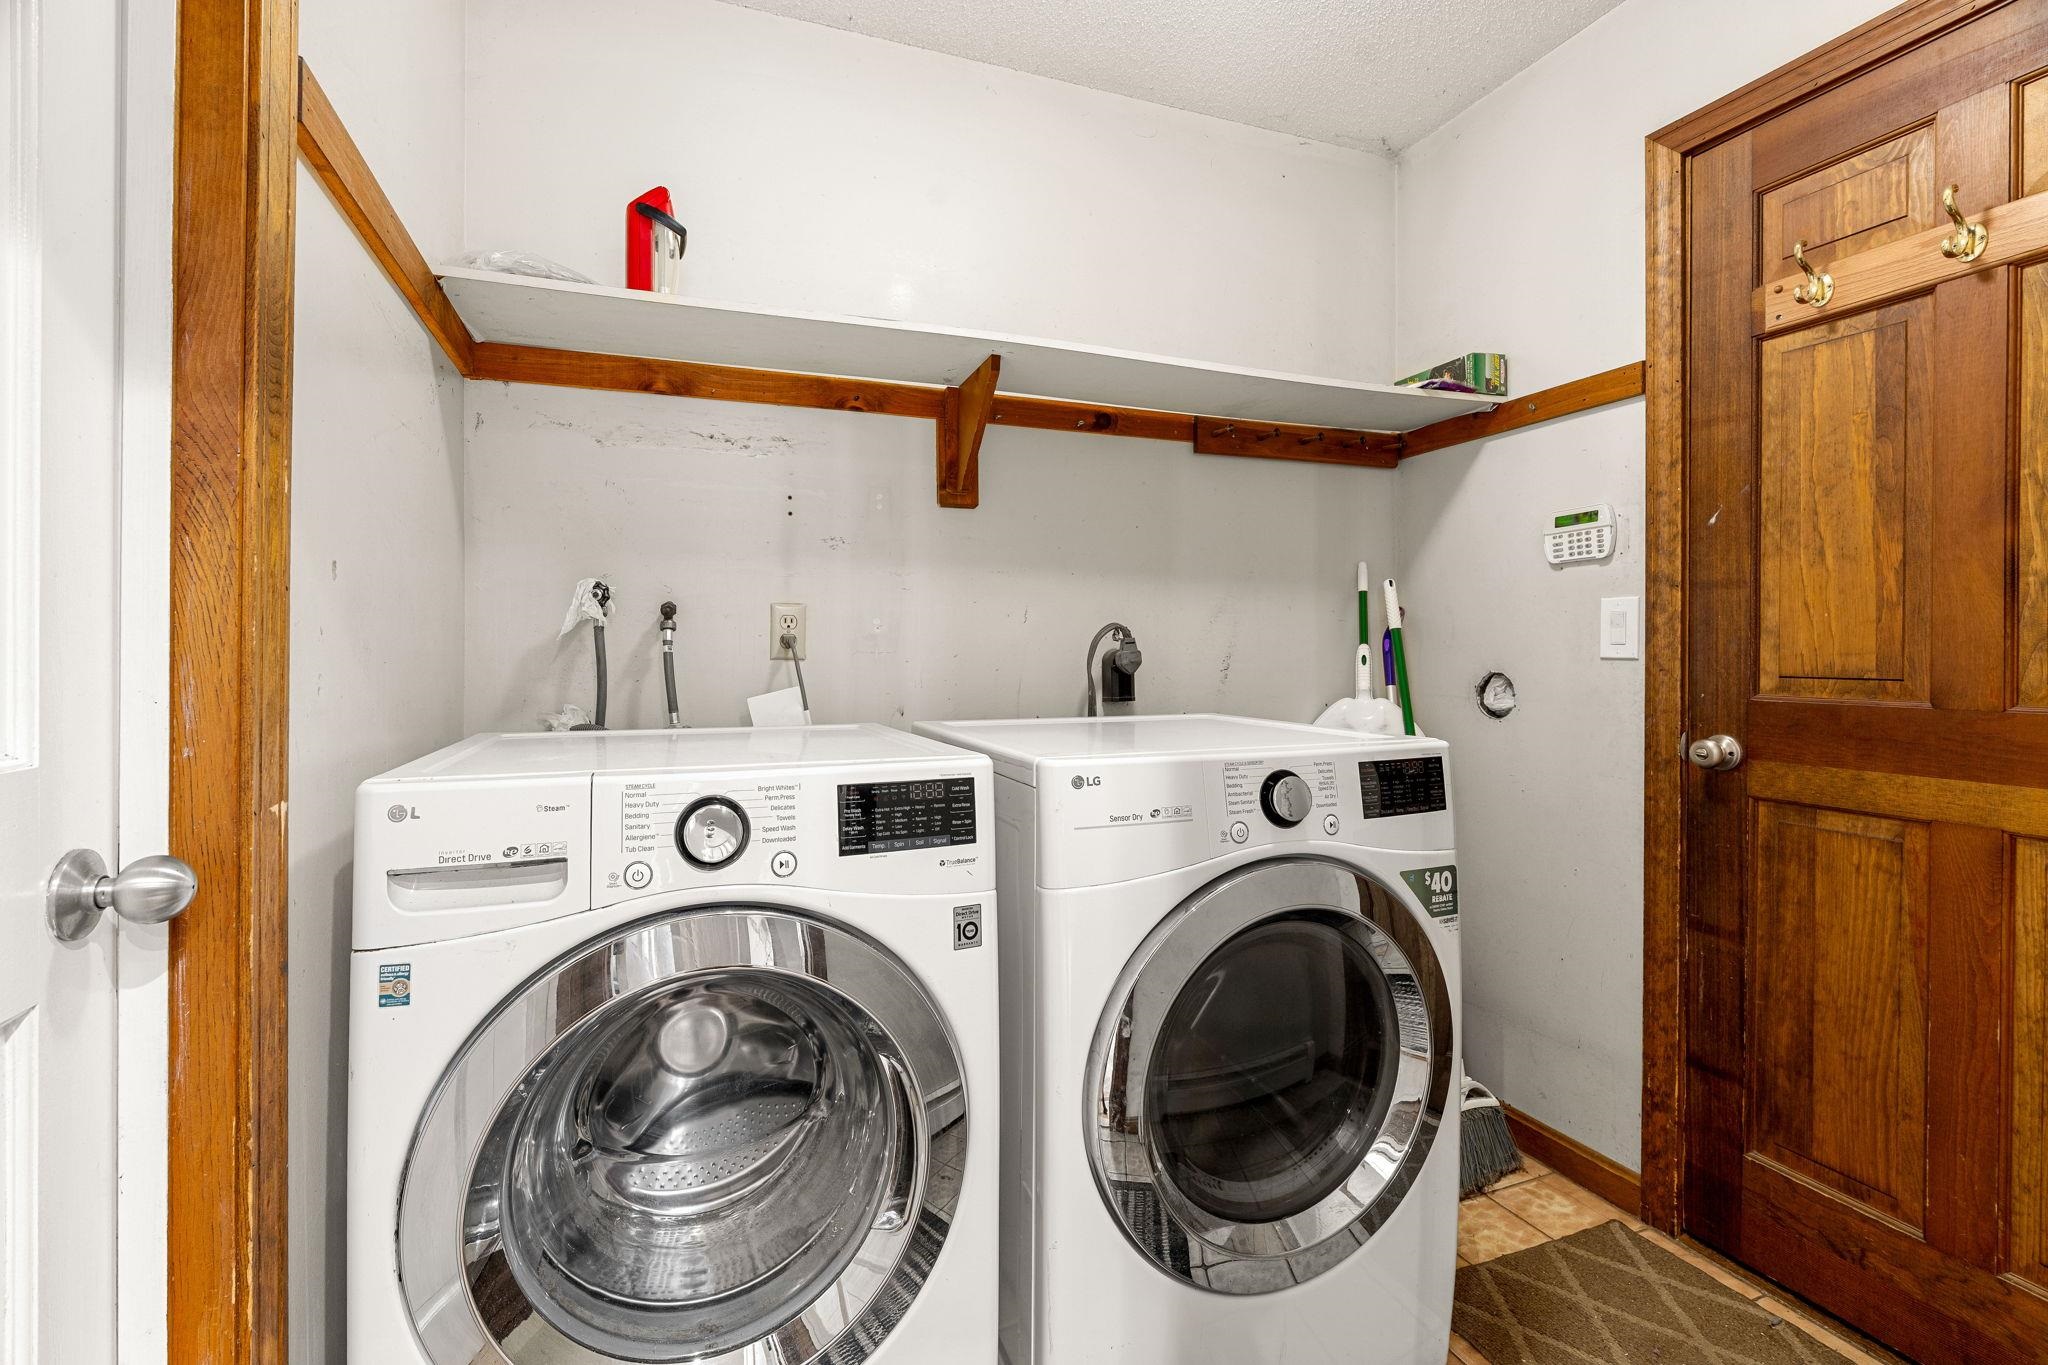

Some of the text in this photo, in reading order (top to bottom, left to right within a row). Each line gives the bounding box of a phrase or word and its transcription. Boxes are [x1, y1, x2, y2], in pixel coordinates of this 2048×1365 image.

[1087, 776, 1101, 786] LG
[1110, 813, 1143, 822] Sensor Dry
[438, 853, 492, 864] Direct Drive
[1425, 871, 1452, 893] $40
[1432, 894, 1452, 903] REBATE
[957, 921, 978, 941] 10
